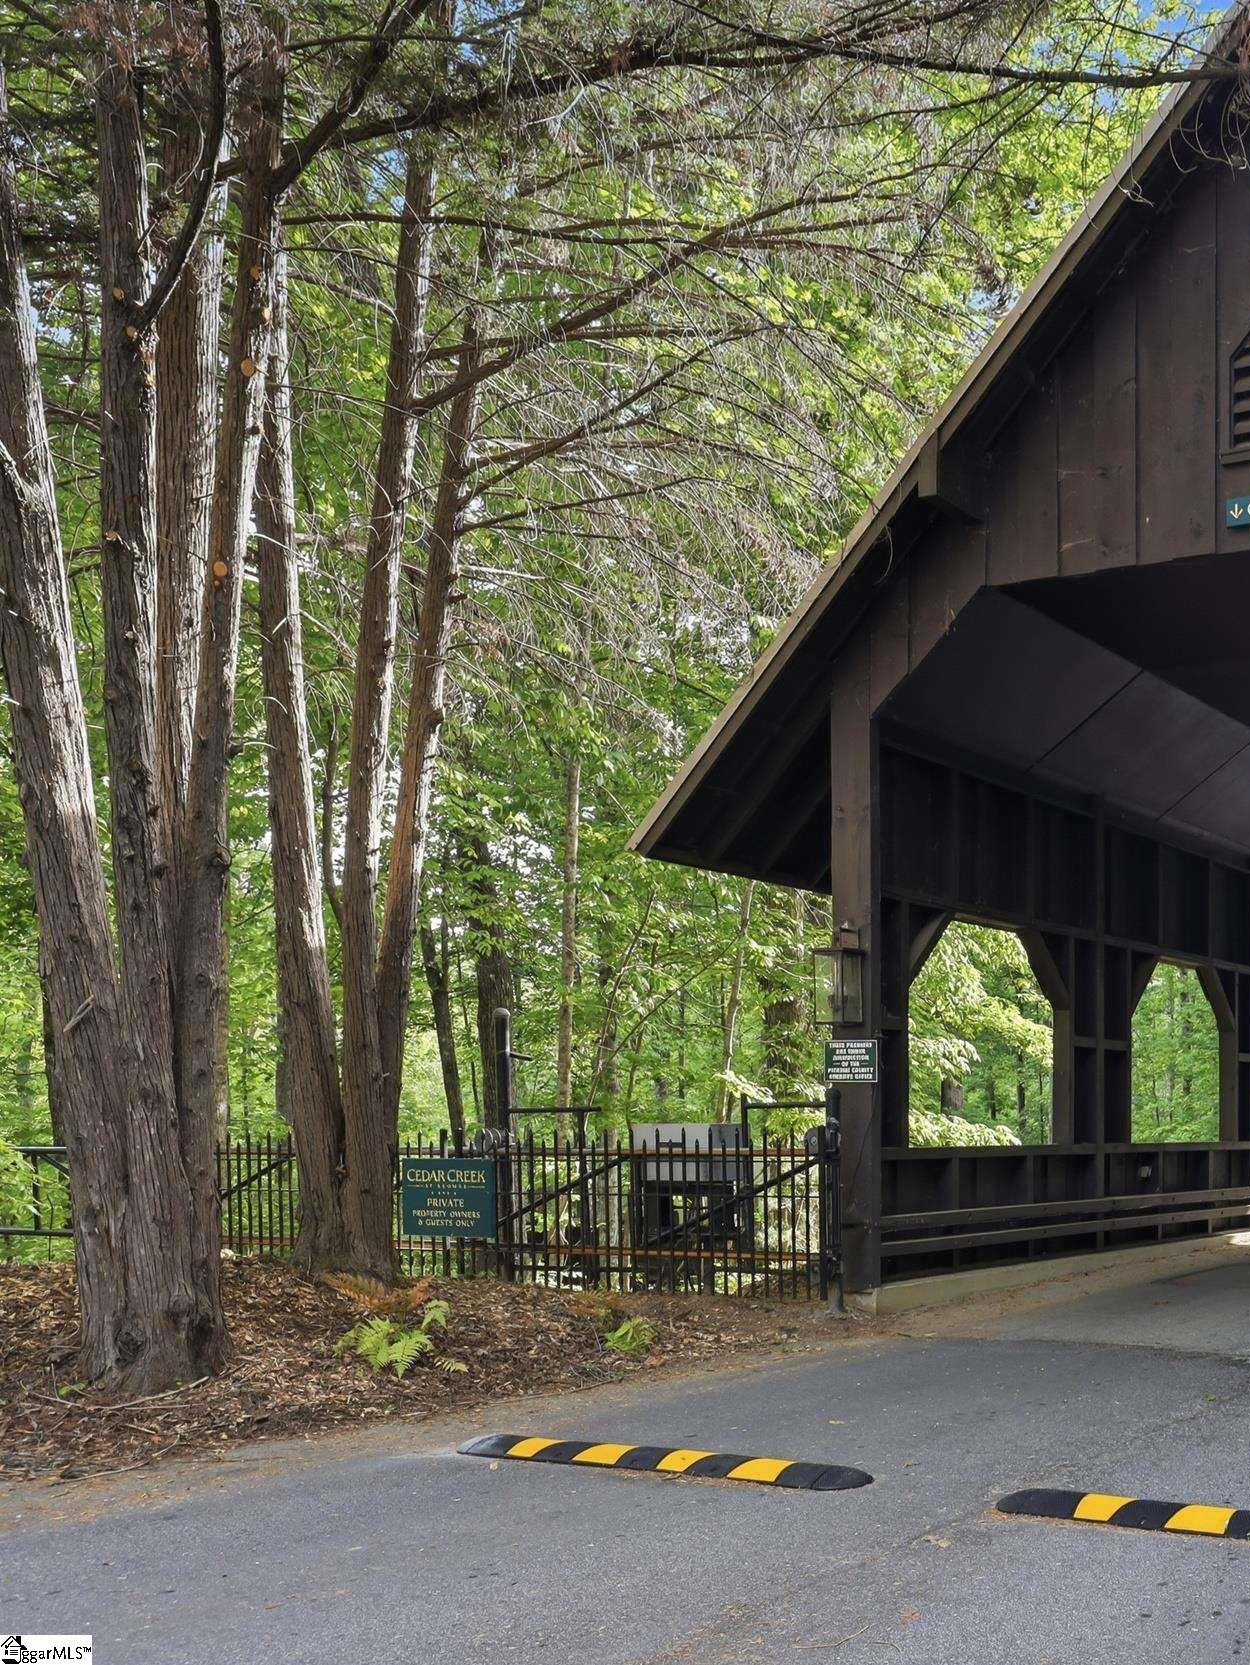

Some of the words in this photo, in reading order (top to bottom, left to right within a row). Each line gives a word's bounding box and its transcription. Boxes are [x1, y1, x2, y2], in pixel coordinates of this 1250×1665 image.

[407, 1168, 446, 1182] CEDAR
[447, 1169, 486, 1183] CREEK
[427, 1198, 465, 1207] PRIVATE
[412, 1209, 447, 1217] PROPERTY
[449, 1211, 481, 1219] OWNERS
[455, 1219, 475, 1227] ONLY
